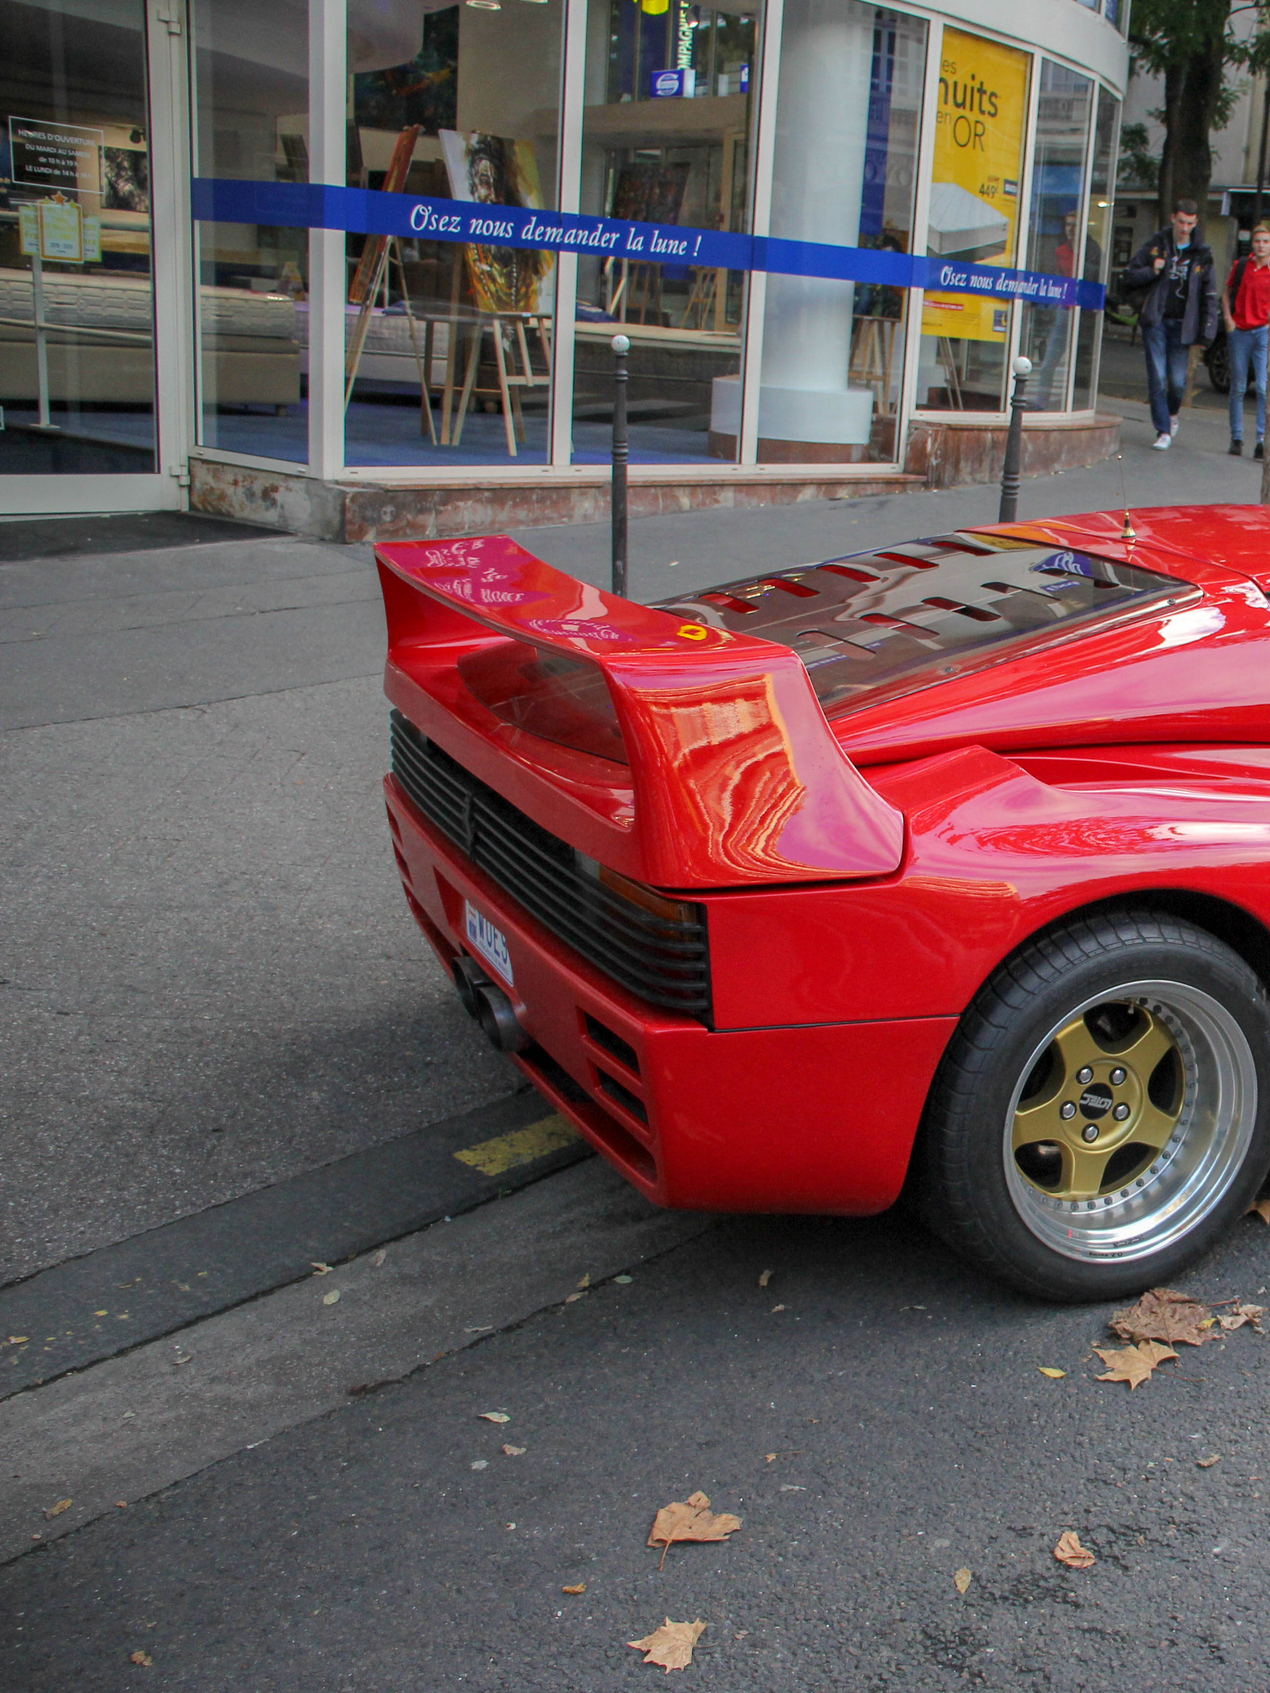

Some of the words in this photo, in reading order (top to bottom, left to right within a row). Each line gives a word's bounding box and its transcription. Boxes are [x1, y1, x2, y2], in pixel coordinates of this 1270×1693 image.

[953, 115, 986, 152] OR
[25, 143, 35, 151] DU
[36, 145, 57, 153] MARDI
[33, 166, 53, 174] LUNDI
[410, 204, 461, 232] Osez
[469, 216, 514, 238] nous
[521, 216, 620, 249] demander
[626, 227, 644, 251] la
[650, 230, 687, 255] lune
[693, 235, 702, 256] !
[941, 265, 967, 286] Osez
[969, 274, 993, 290] nous
[995, 272, 1039, 296] demander
[1039, 278, 1048, 296] la
[1047, 280, 1062, 299] lune
[1062, 283, 1068, 299] !
[1079, 1093, 1113, 1110] LOTEC
